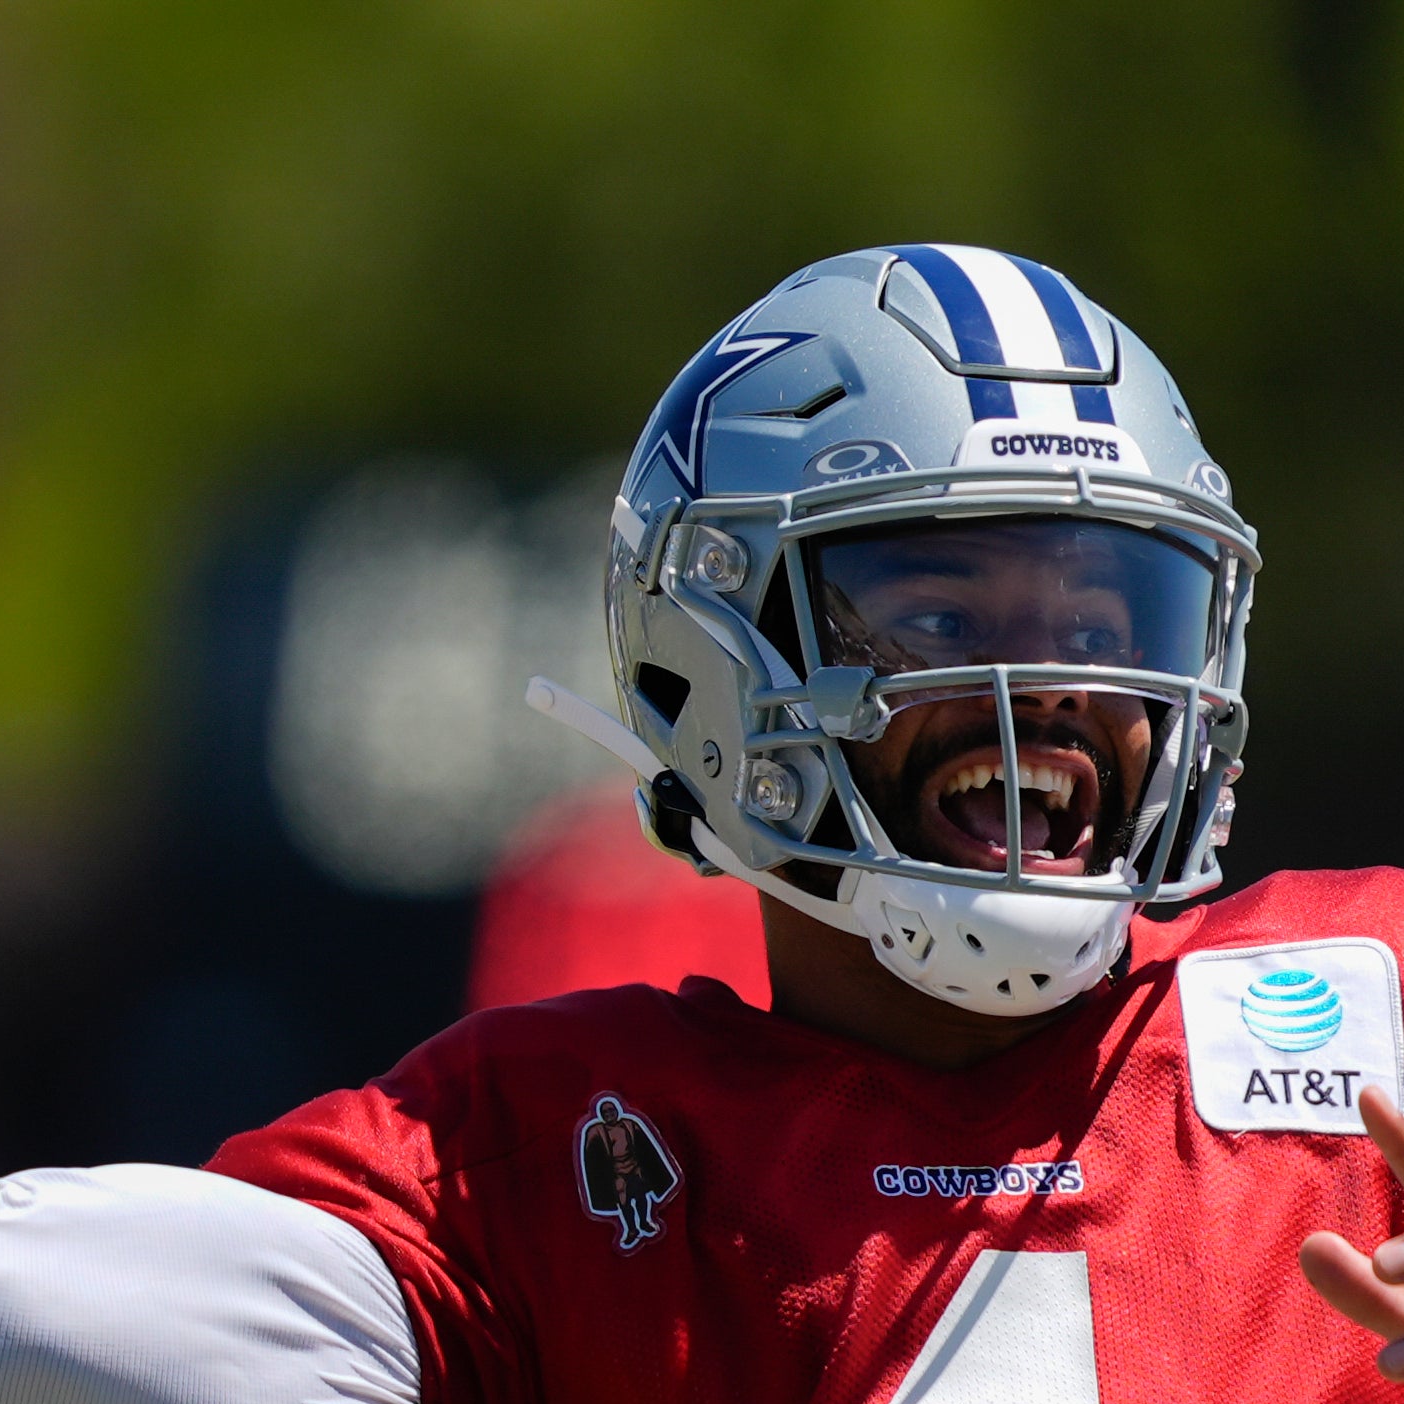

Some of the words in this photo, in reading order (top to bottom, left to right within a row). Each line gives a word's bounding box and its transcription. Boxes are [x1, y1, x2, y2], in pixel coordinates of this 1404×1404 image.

[991, 434, 1120, 462] COWBOYS
[1242, 1068, 1361, 1108] AT&T
[873, 1159, 1085, 1198] COWBOYS
